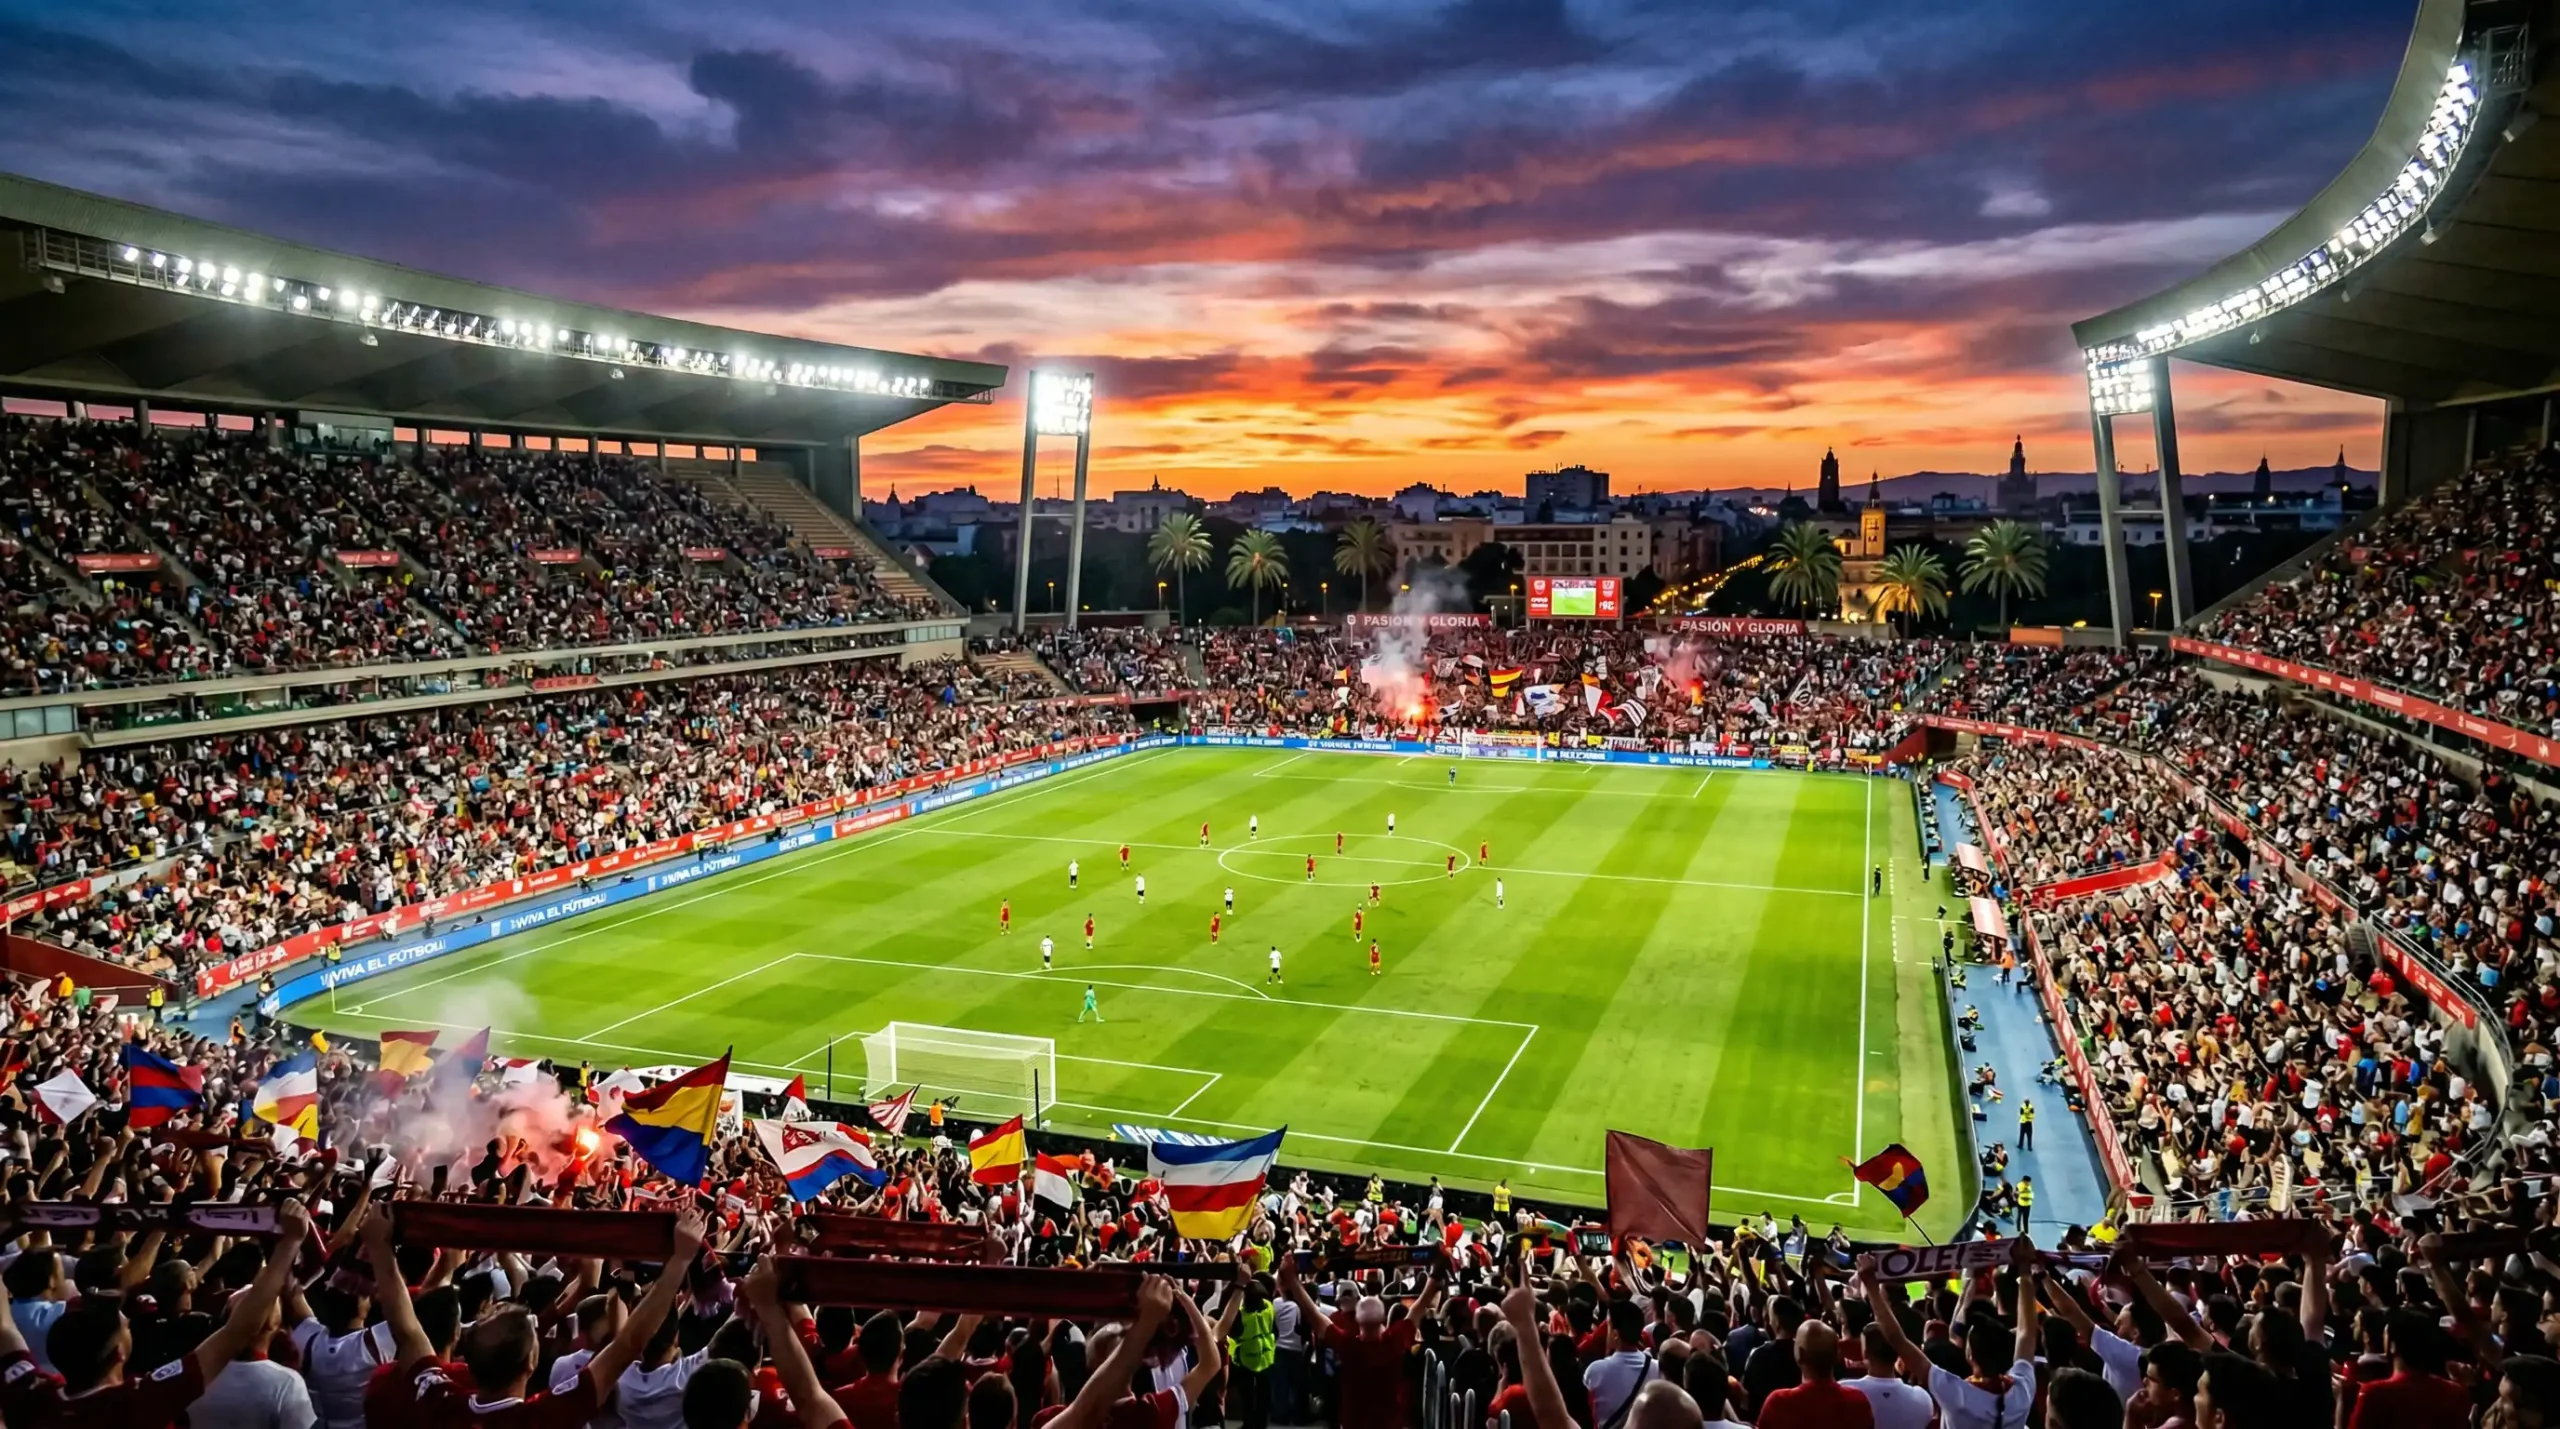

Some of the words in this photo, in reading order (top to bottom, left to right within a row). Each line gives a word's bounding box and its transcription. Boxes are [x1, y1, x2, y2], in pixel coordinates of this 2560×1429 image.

[1429, 616, 1481, 627] GLORIA
[1680, 619, 1731, 632] PASIÓN
[1736, 622, 1745, 632] Y
[1748, 622, 1799, 634] GLORIA
[546, 905, 561, 919] EL
[367, 958, 387, 972] EL
